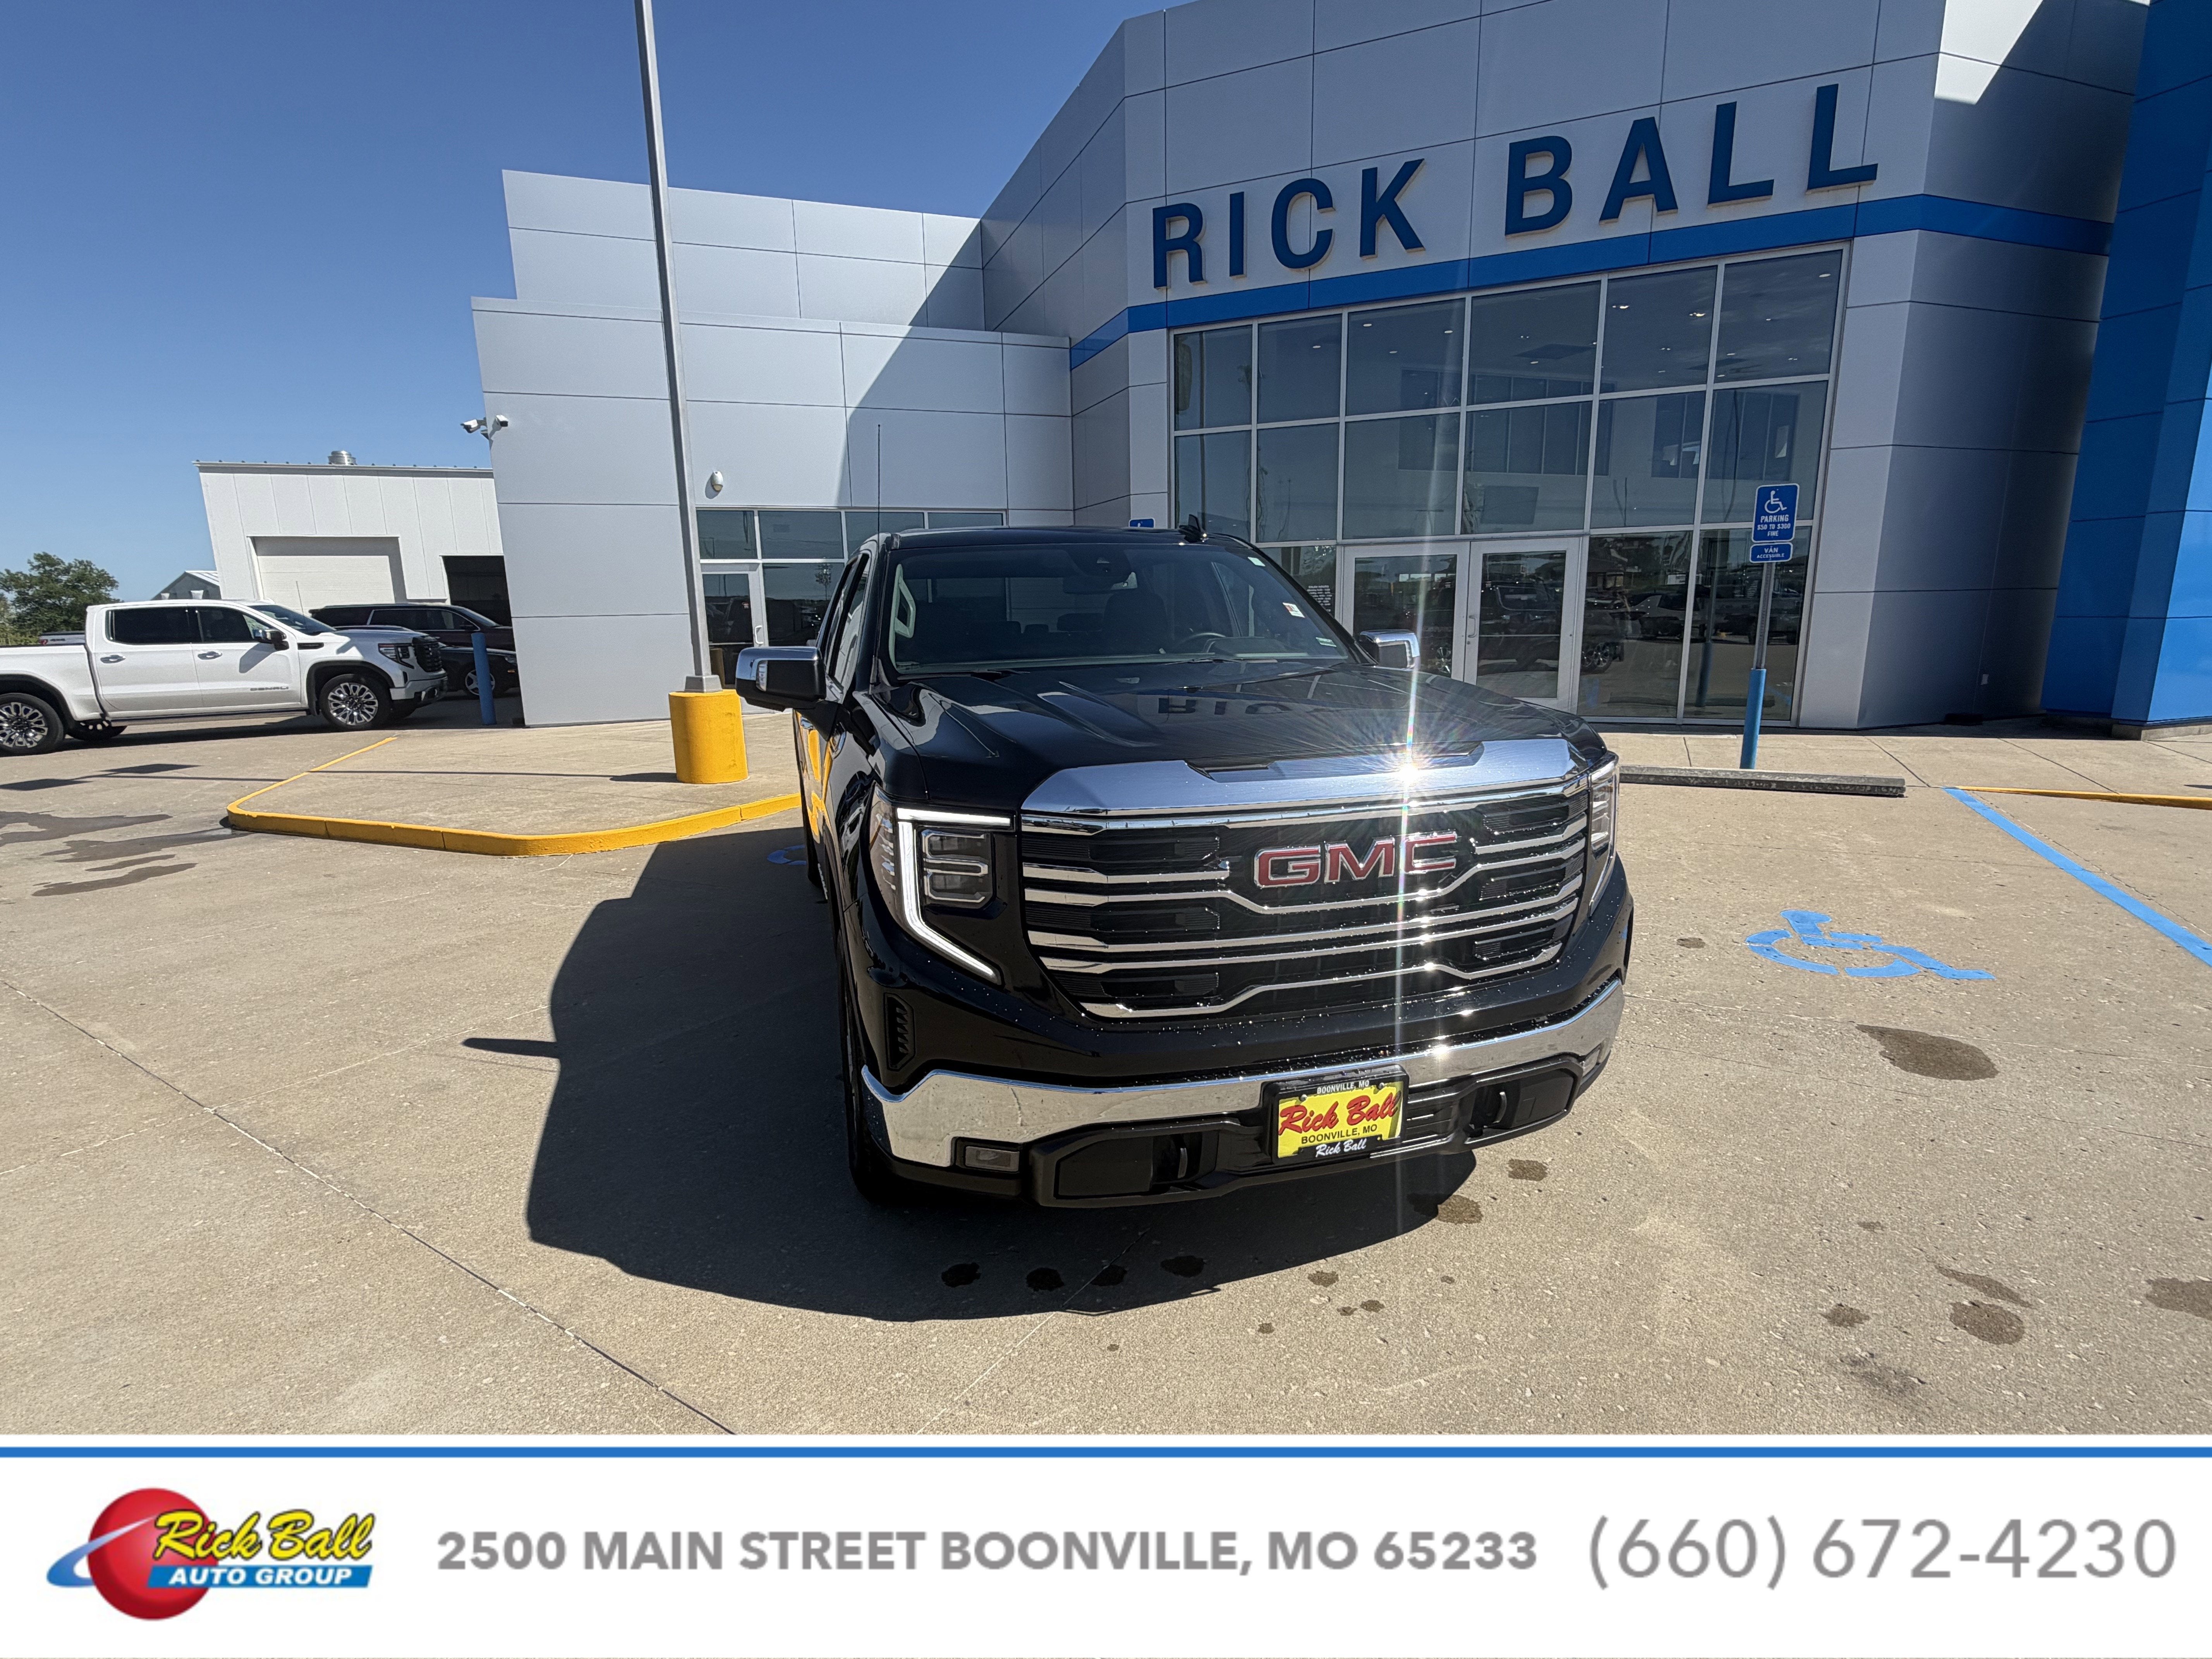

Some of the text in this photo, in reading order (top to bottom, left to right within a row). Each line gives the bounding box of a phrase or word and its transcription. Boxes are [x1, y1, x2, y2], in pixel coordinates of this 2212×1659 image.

[1153, 84, 1879, 289] RICK BALL
[1760, 514, 1789, 523] PARKING
[1254, 831, 1458, 888] GMC
[1317, 1082, 1356, 1094] BOONVILLE,
[1278, 1091, 1402, 1135] Rick Ball
[1301, 1124, 1377, 1144] BOONVILLE, MO
[1316, 1139, 1366, 1158] Rick Ball
